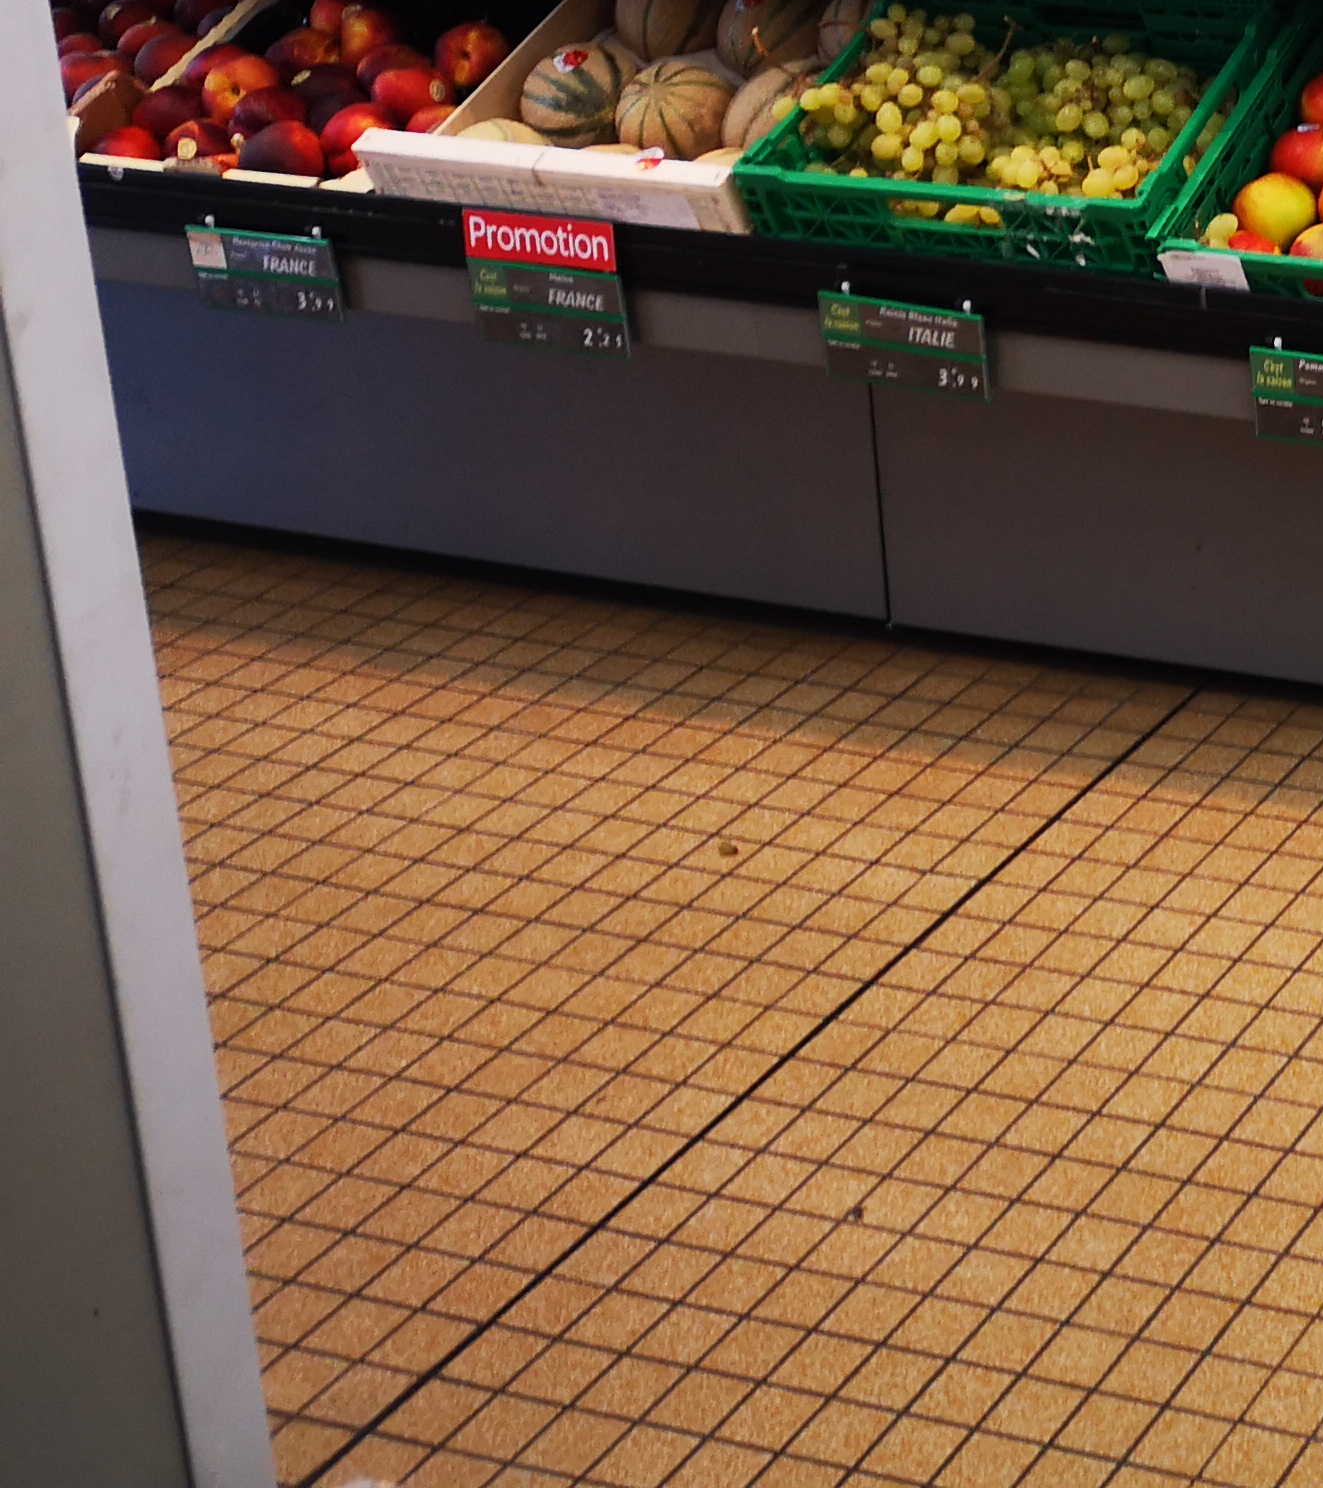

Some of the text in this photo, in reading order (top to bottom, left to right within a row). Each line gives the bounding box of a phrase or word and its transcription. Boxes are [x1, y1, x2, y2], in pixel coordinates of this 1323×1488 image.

[468, 215, 609, 262] Promotion
[263, 255, 316, 277] FRANCE
[548, 287, 604, 312] FRANCE
[908, 326, 955, 349] ITALIE
